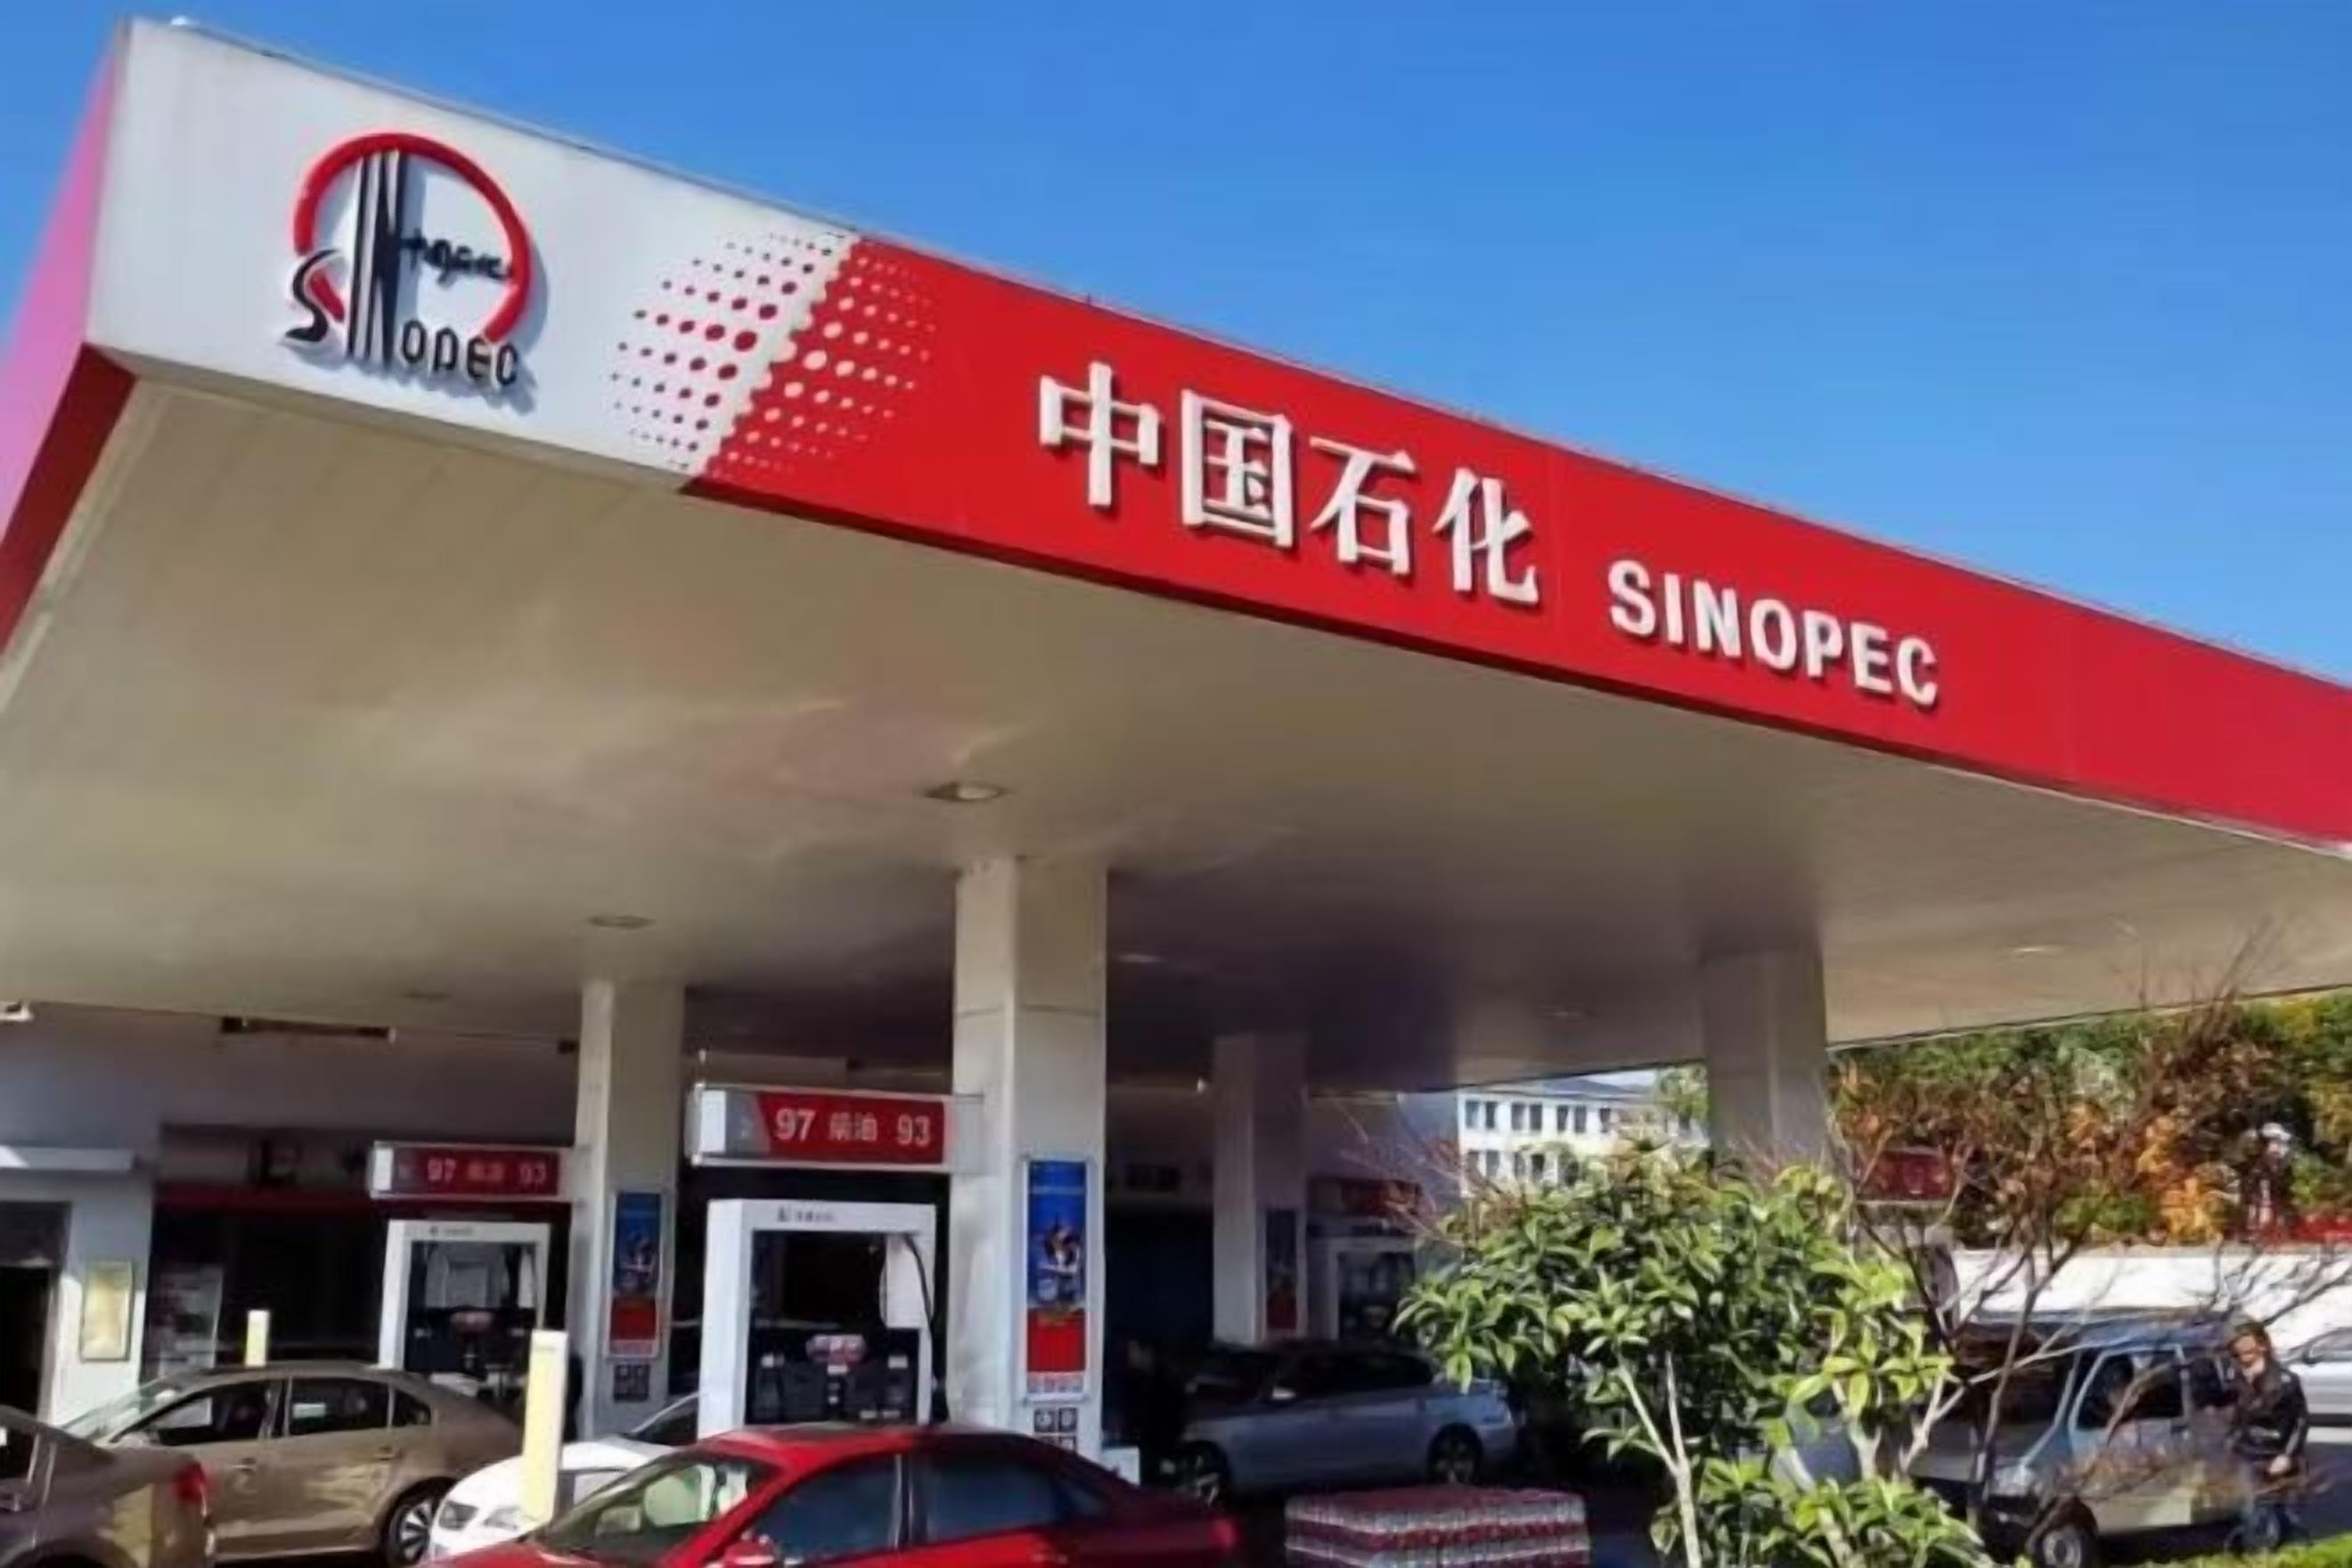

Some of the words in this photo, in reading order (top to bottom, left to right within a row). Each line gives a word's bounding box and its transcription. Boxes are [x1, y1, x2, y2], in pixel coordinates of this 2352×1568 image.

[1039, 360, 1539, 606] 中国石化
[1608, 559, 1939, 706] SINOPEC
[775, 1107, 816, 1141] 97
[896, 1114, 930, 1147] 93
